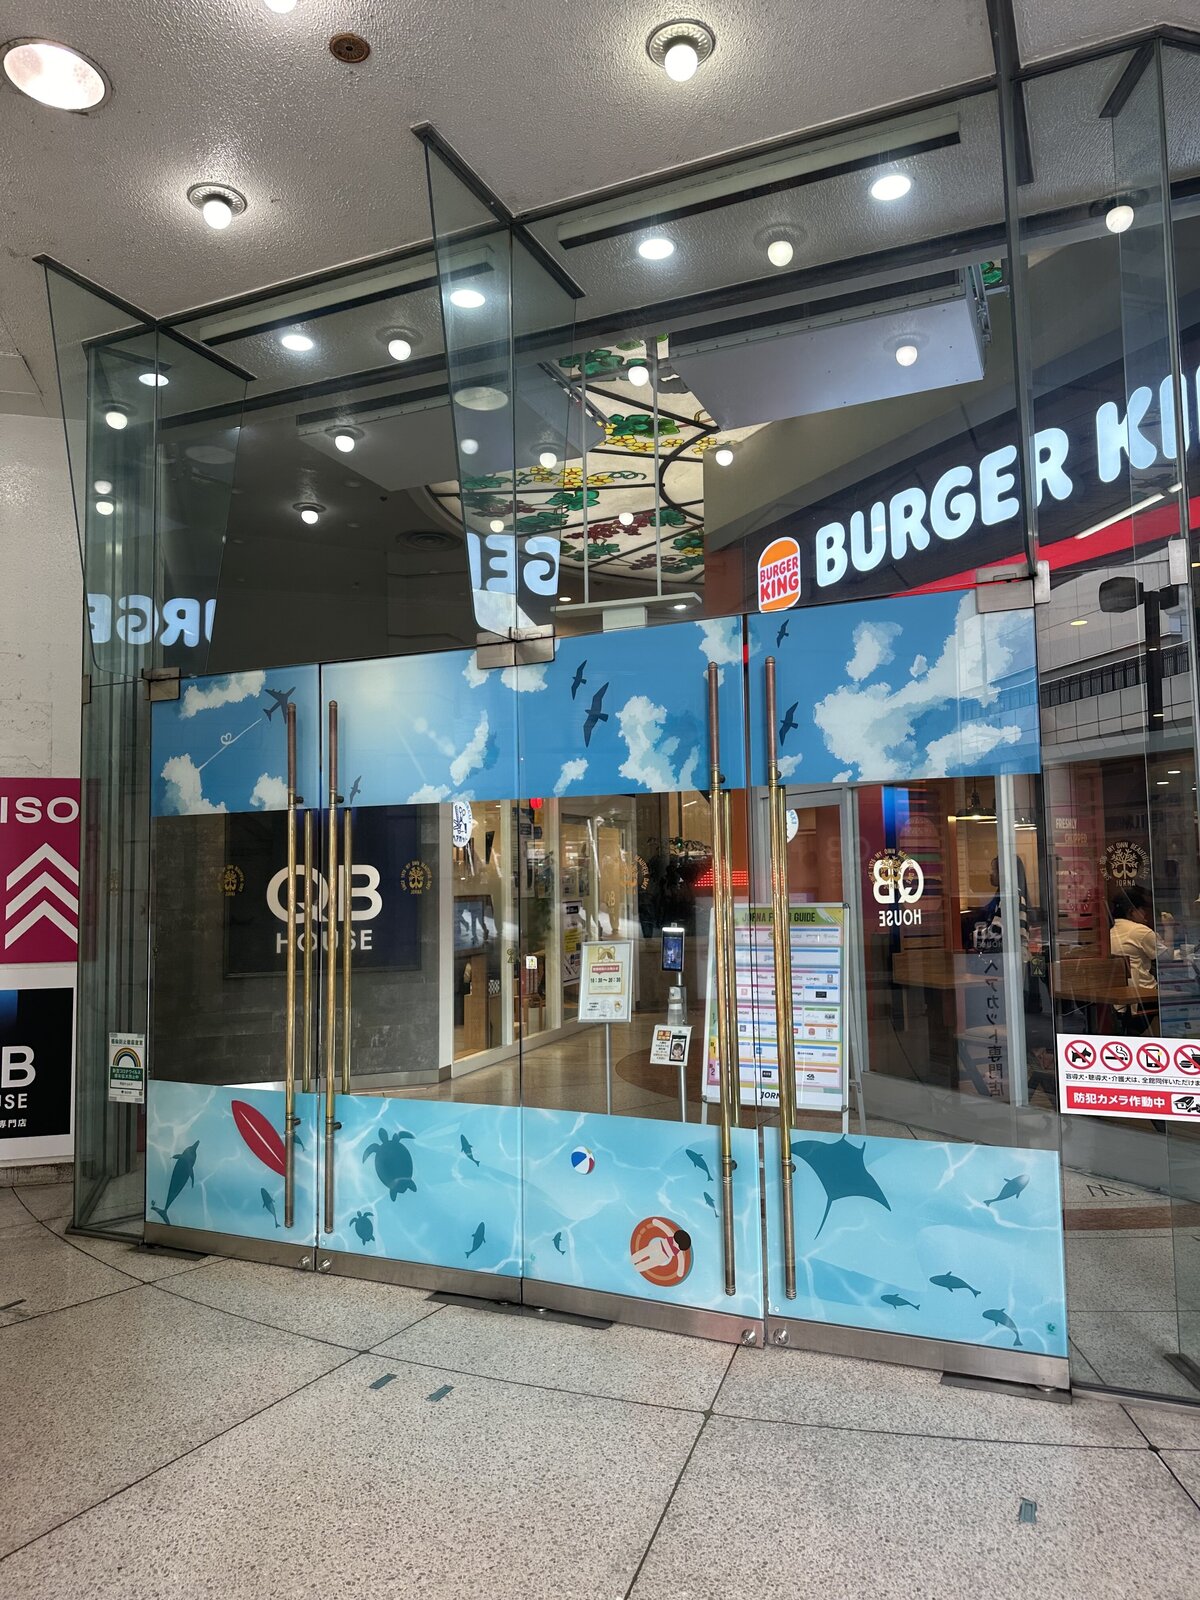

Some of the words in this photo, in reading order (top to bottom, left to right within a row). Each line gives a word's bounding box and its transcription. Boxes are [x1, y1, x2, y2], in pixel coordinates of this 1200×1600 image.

[816, 427, 1074, 588] BURGER
[1096, 366, 1200, 484] KI
[760, 556, 799, 583] BURGER
[760, 571, 800, 602] KING
[266, 864, 383, 924] QB
[794, 912, 816, 922] GUIDE
[0, 1093, 28, 1110] SE
[760, 1091, 780, 1100] JORN
[1073, 1092, 1166, 1109] 防犯カメラ作動中
